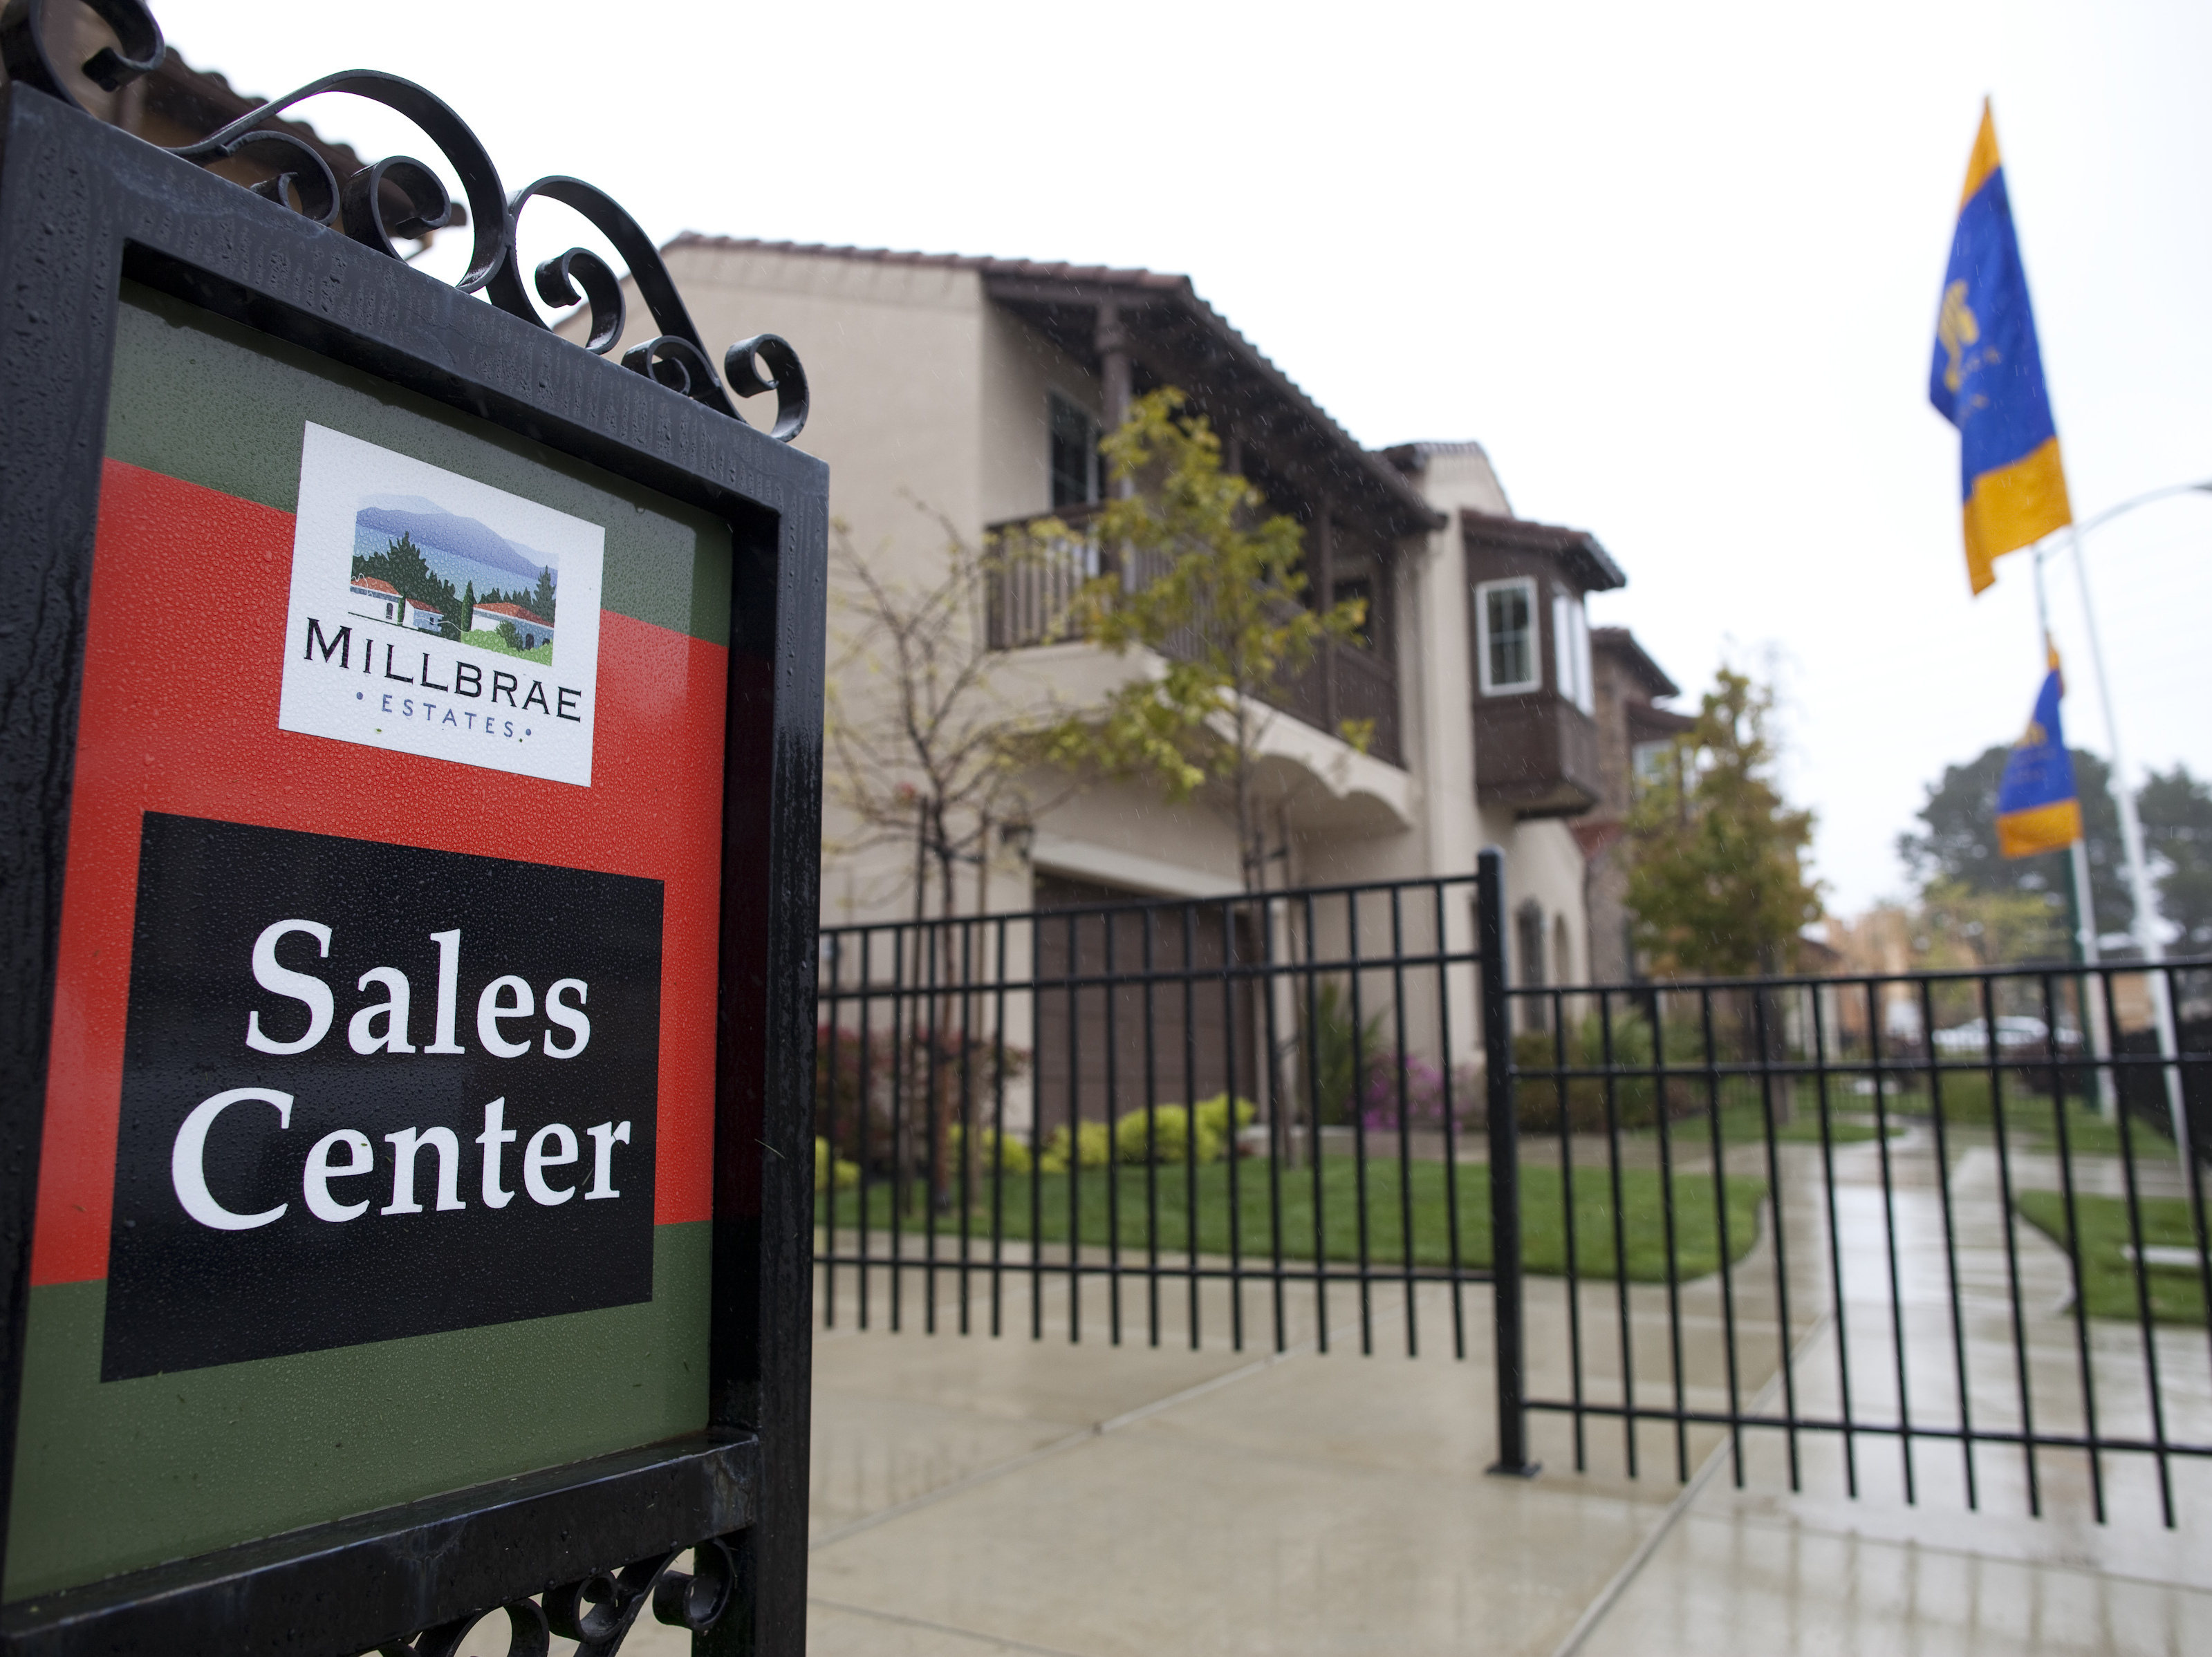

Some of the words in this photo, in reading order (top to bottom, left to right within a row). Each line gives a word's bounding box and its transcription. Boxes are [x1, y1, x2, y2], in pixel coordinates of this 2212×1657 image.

[304, 617, 582, 723] MILLBRAE
[382, 694, 514, 738] ESTATES
[245, 918, 591, 1059] Sales
[171, 1087, 631, 1230] Center
